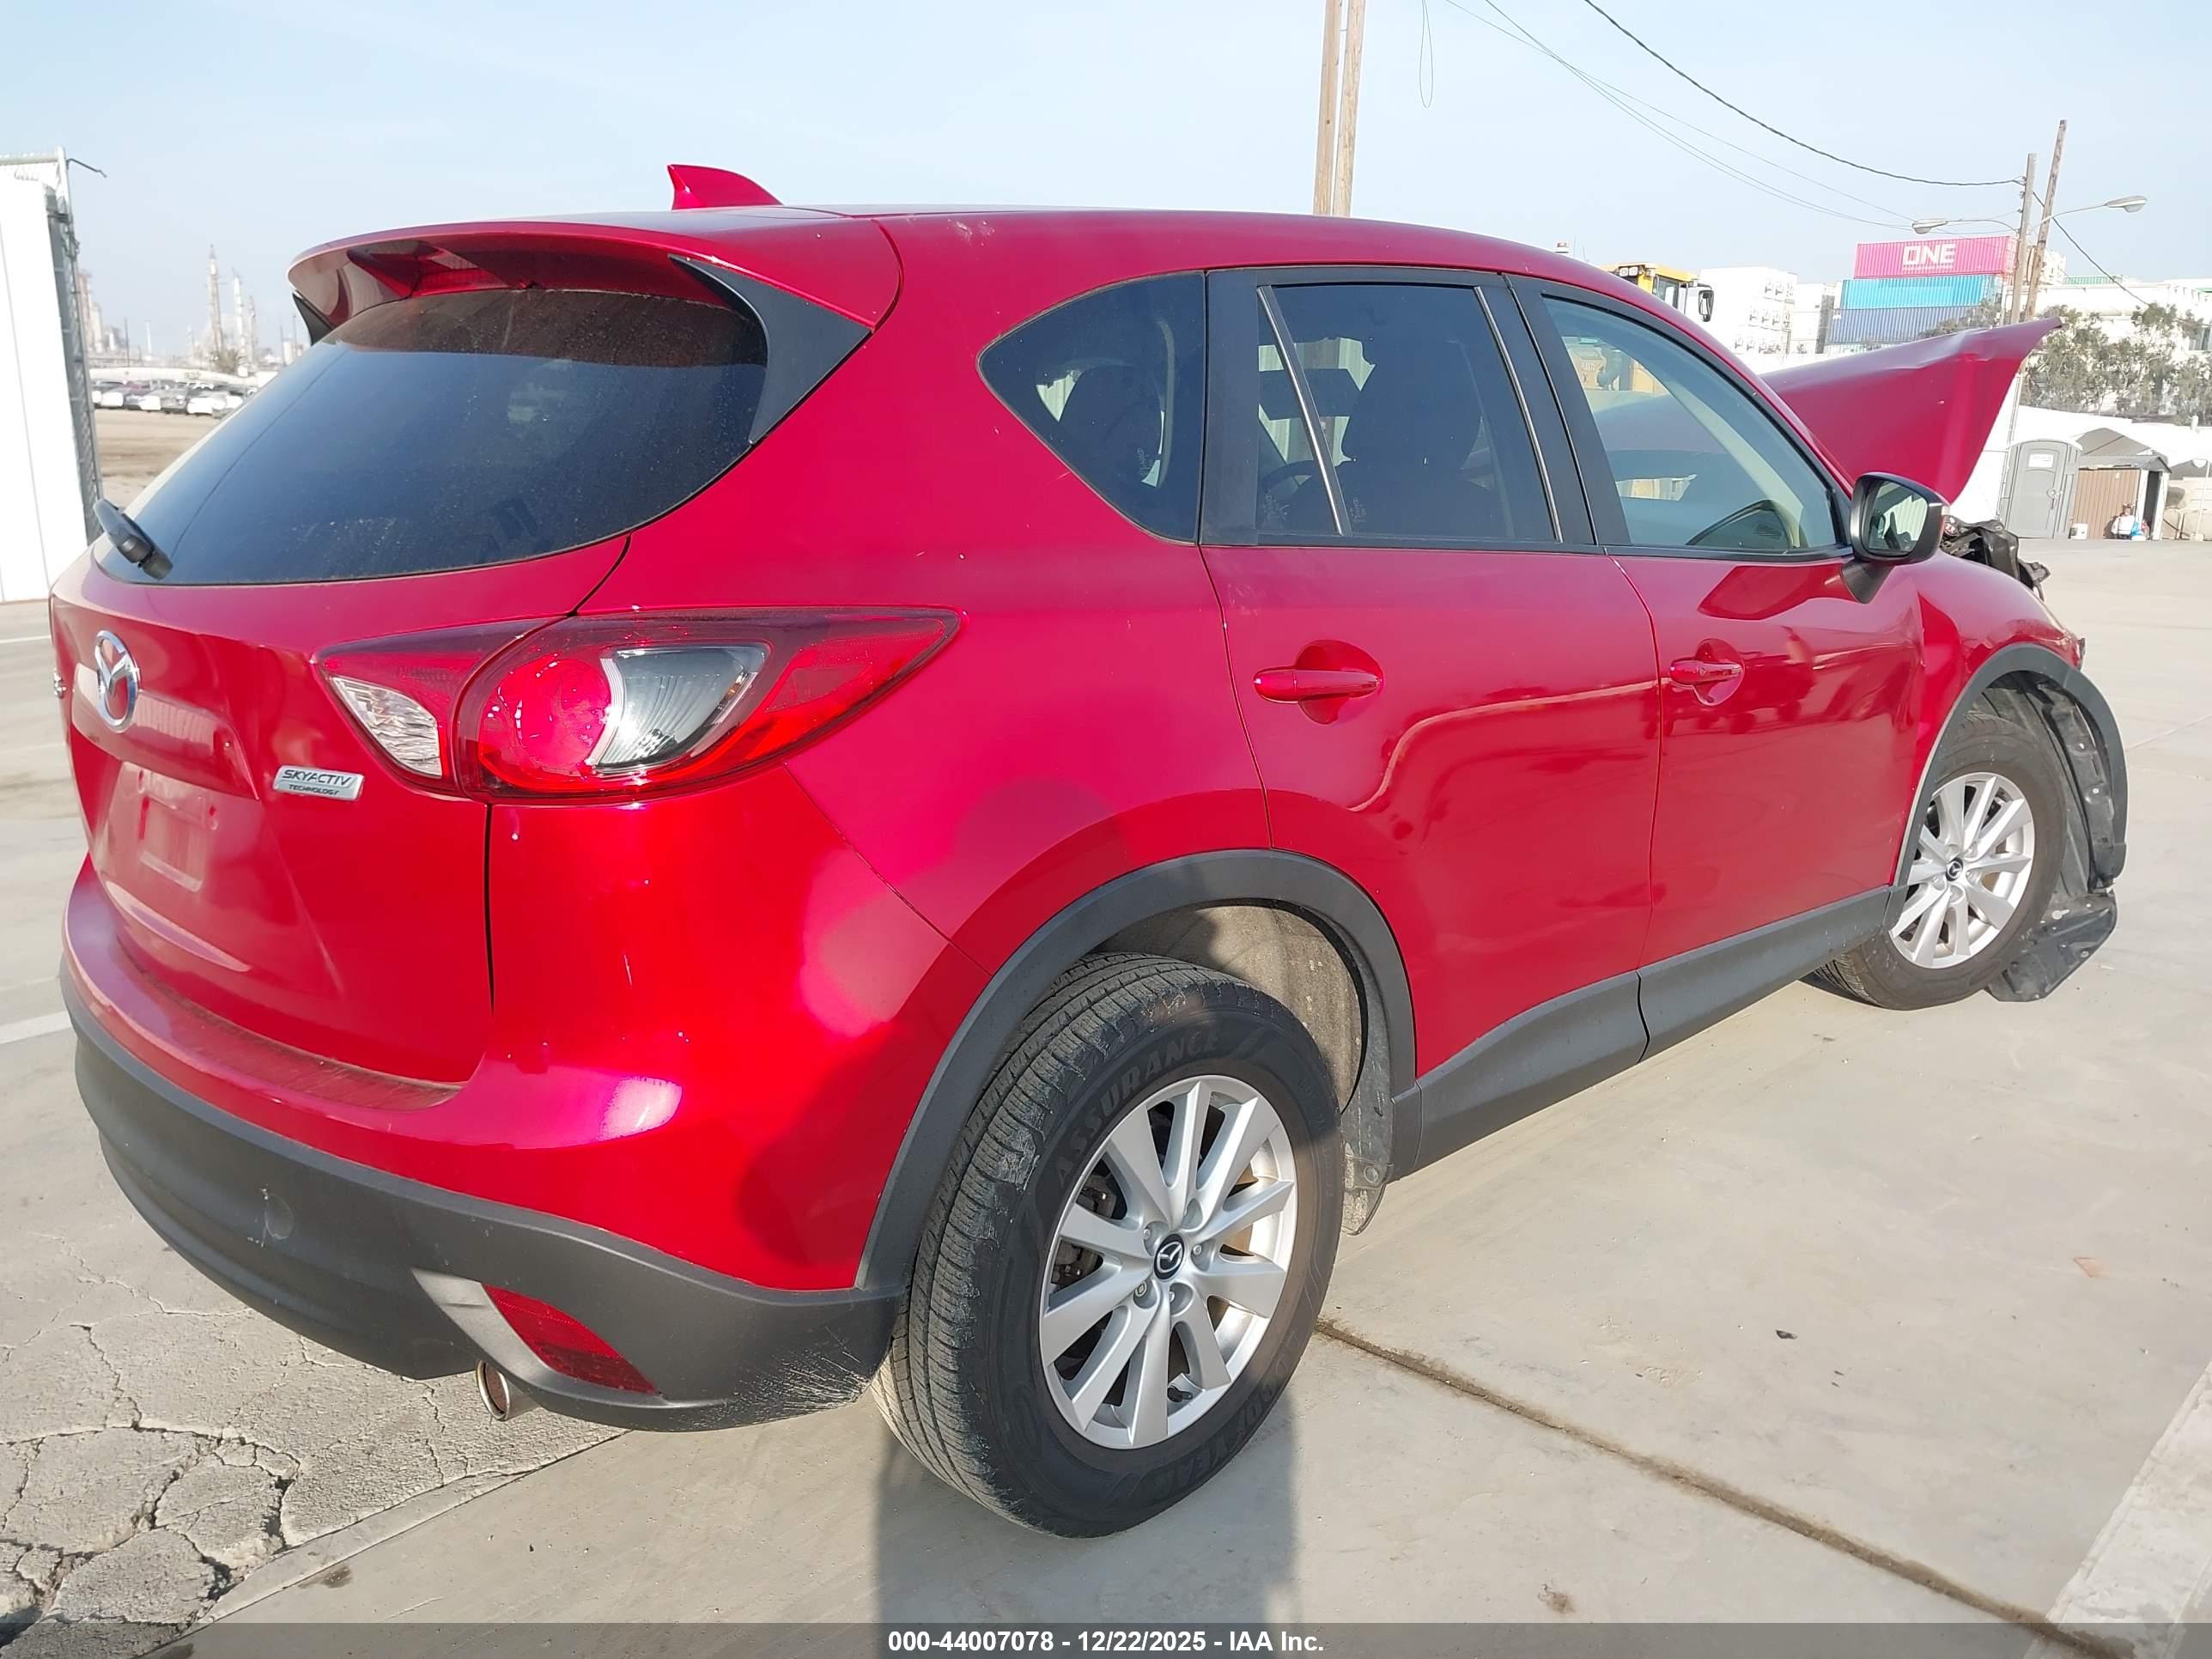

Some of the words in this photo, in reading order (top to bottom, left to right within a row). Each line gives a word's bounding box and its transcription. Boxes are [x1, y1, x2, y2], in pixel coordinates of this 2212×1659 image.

[1902, 244, 1956, 265] ONE
[282, 769, 352, 786] SKYACTIV
[289, 783, 340, 795] TECHNOLOGY
[1056, 1029, 1219, 1188] ASSURANCE
